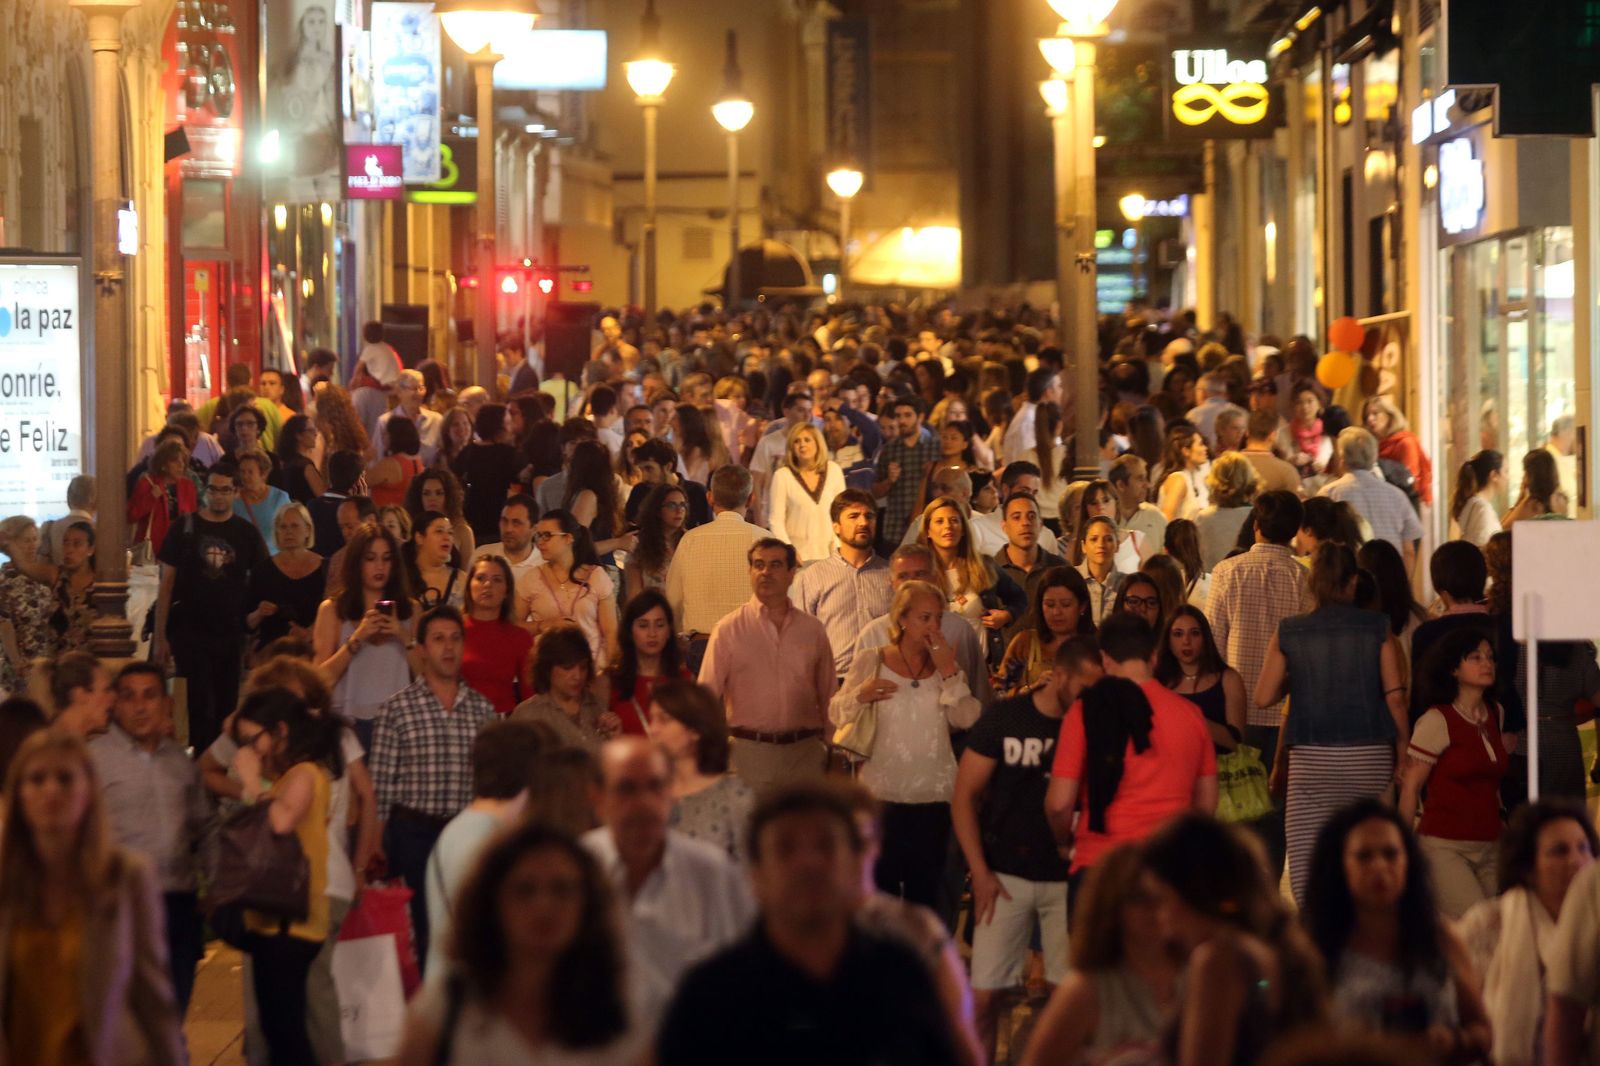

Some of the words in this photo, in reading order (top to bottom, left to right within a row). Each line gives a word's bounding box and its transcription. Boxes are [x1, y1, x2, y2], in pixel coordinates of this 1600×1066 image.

[15, 301, 31, 330] la
[39, 308, 73, 338] paz
[20, 420, 68, 453] Feliz
